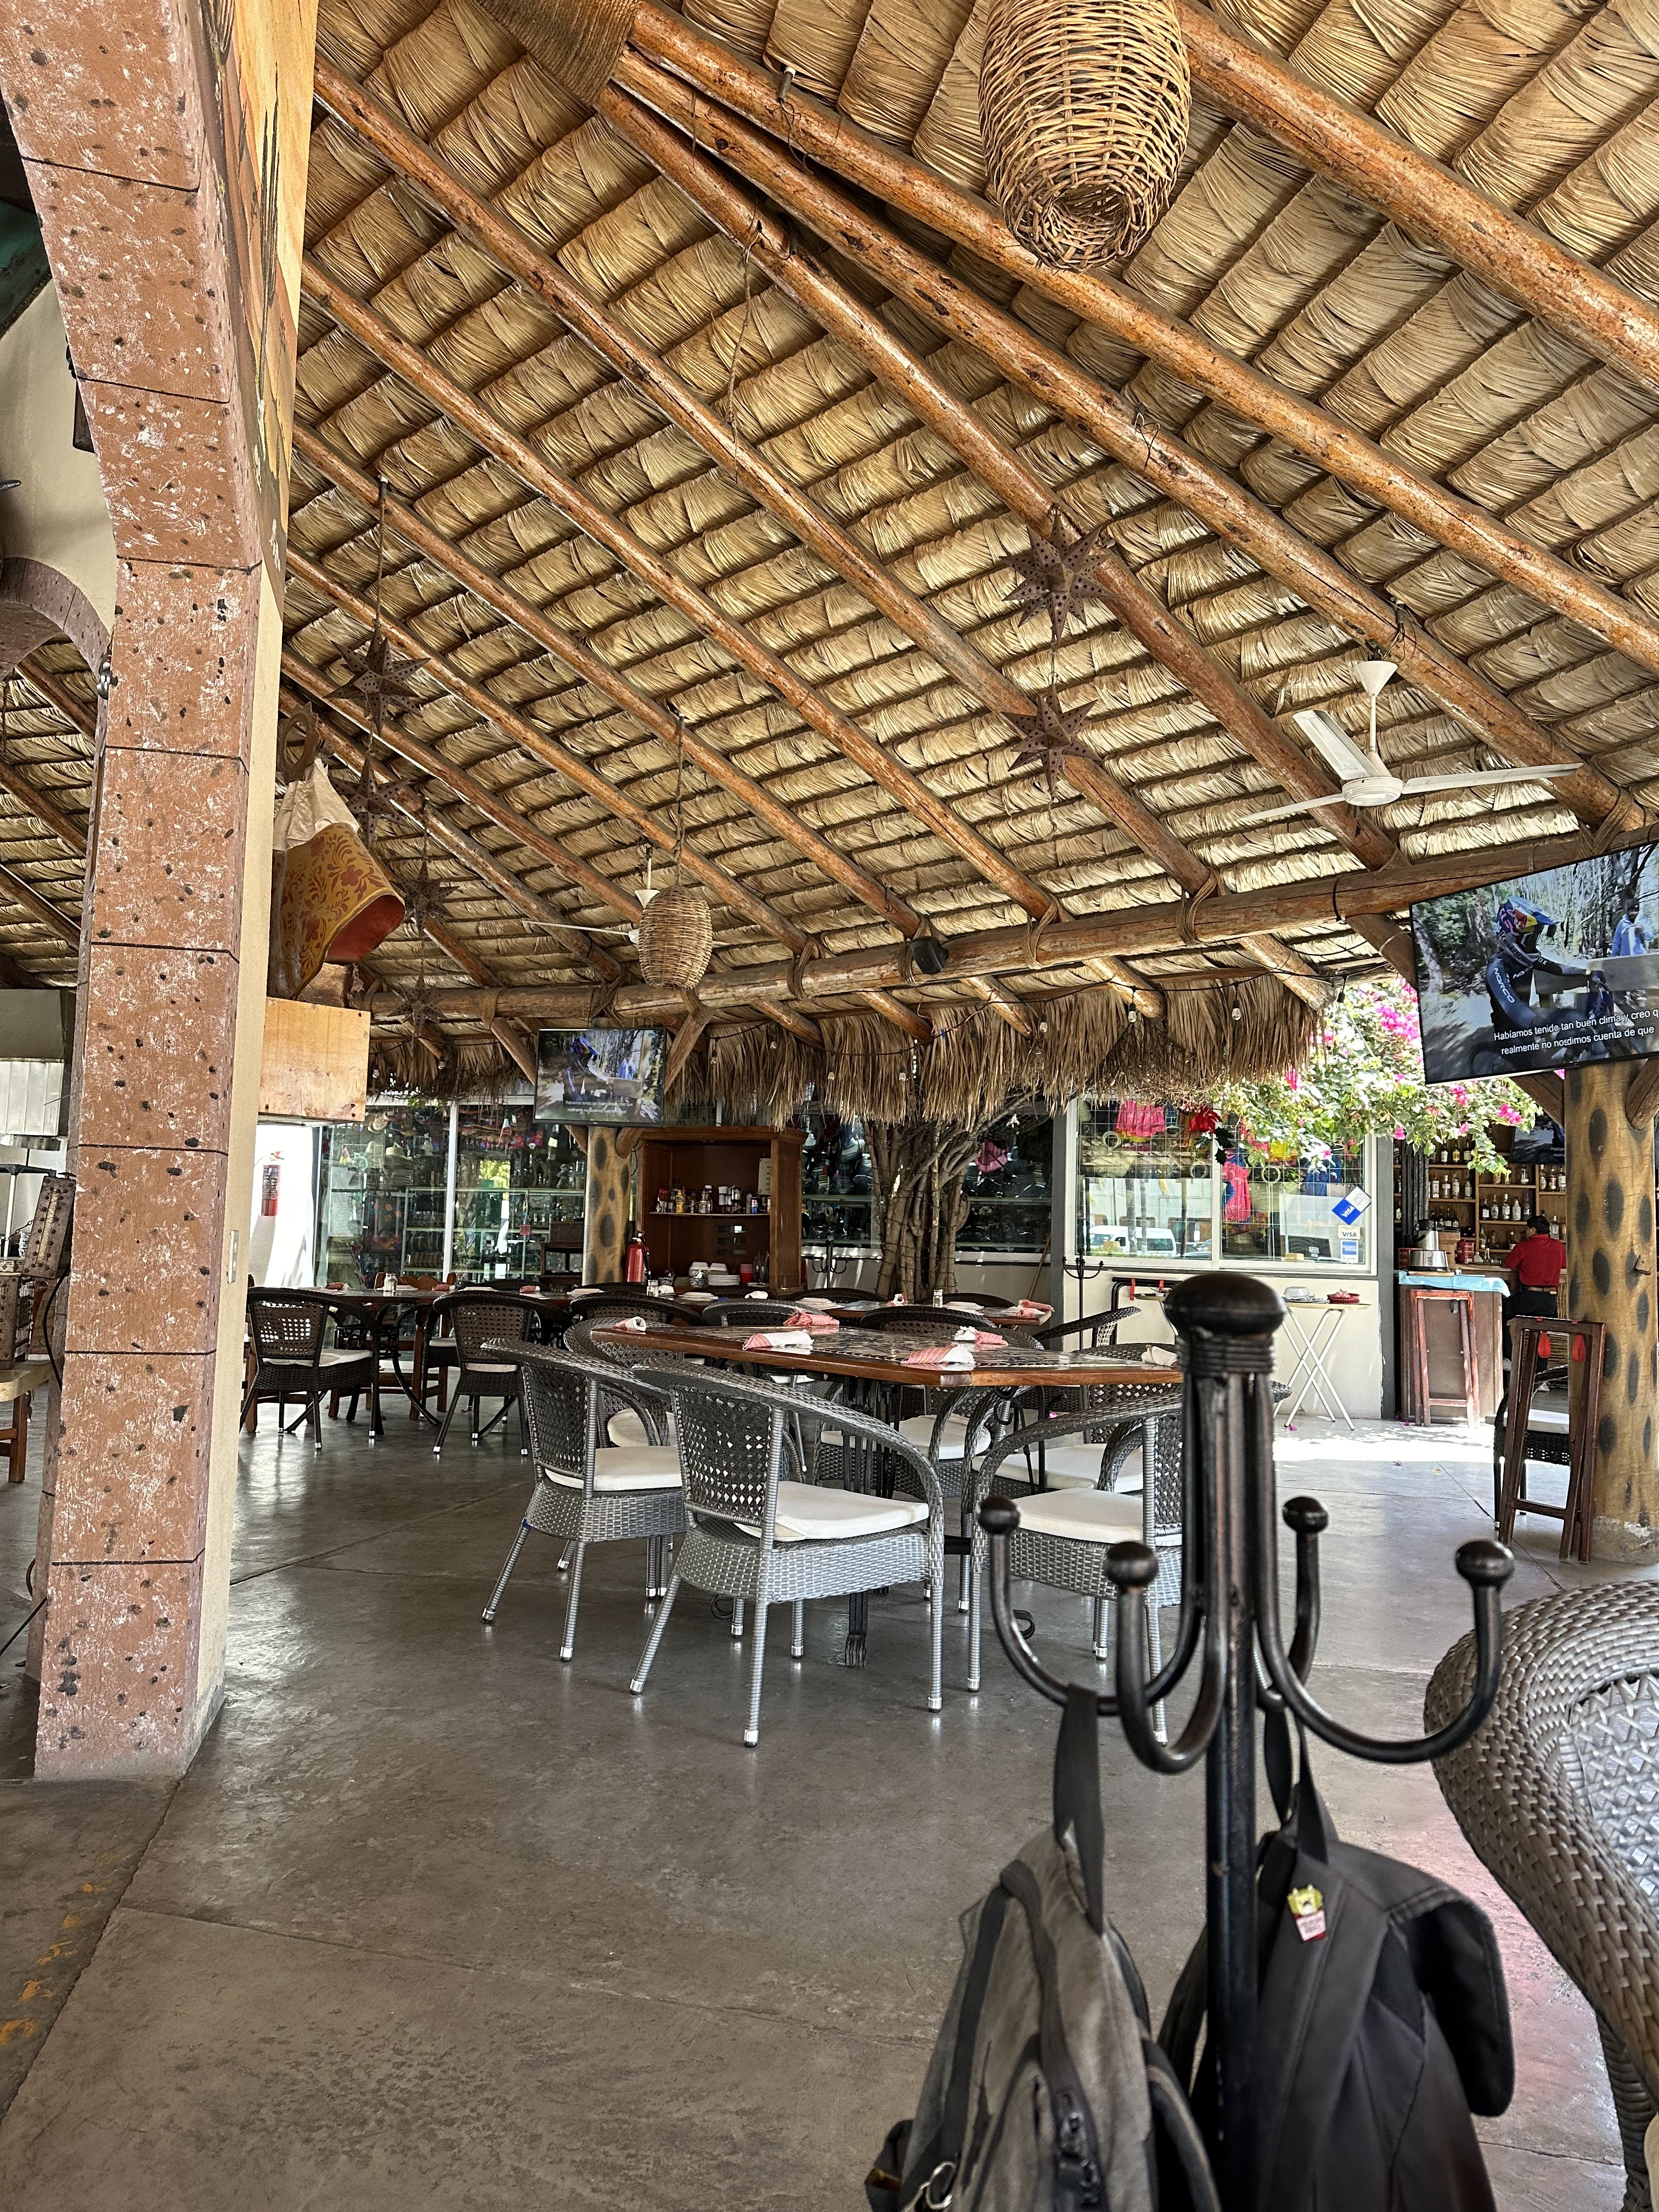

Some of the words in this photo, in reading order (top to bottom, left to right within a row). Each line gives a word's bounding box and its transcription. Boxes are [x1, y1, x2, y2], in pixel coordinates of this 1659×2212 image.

[1538, 957, 1548, 965] OX
[1494, 968, 1515, 1003] NORCO
[1493, 1029, 1533, 1041] Habíamos
[1534, 1024, 1559, 1035] tenido
[1561, 1022, 1574, 1031] tan
[1576, 1019, 1597, 1029] buen
[1599, 1015, 1621, 1025] clima
[1623, 1013, 1629, 1023] y
[1631, 1011, 1651, 1020] creo
[1501, 1043, 1540, 1055] realmente
[1554, 1039, 1567, 1047] nos
[1567, 1035, 1592, 1045] dimos
[1593, 1030, 1622, 1041] cuenta
[1624, 1028, 1635, 1037] de
[1638, 1026, 1655, 1036] que
[1341, 1205, 1355, 1217] VISA
